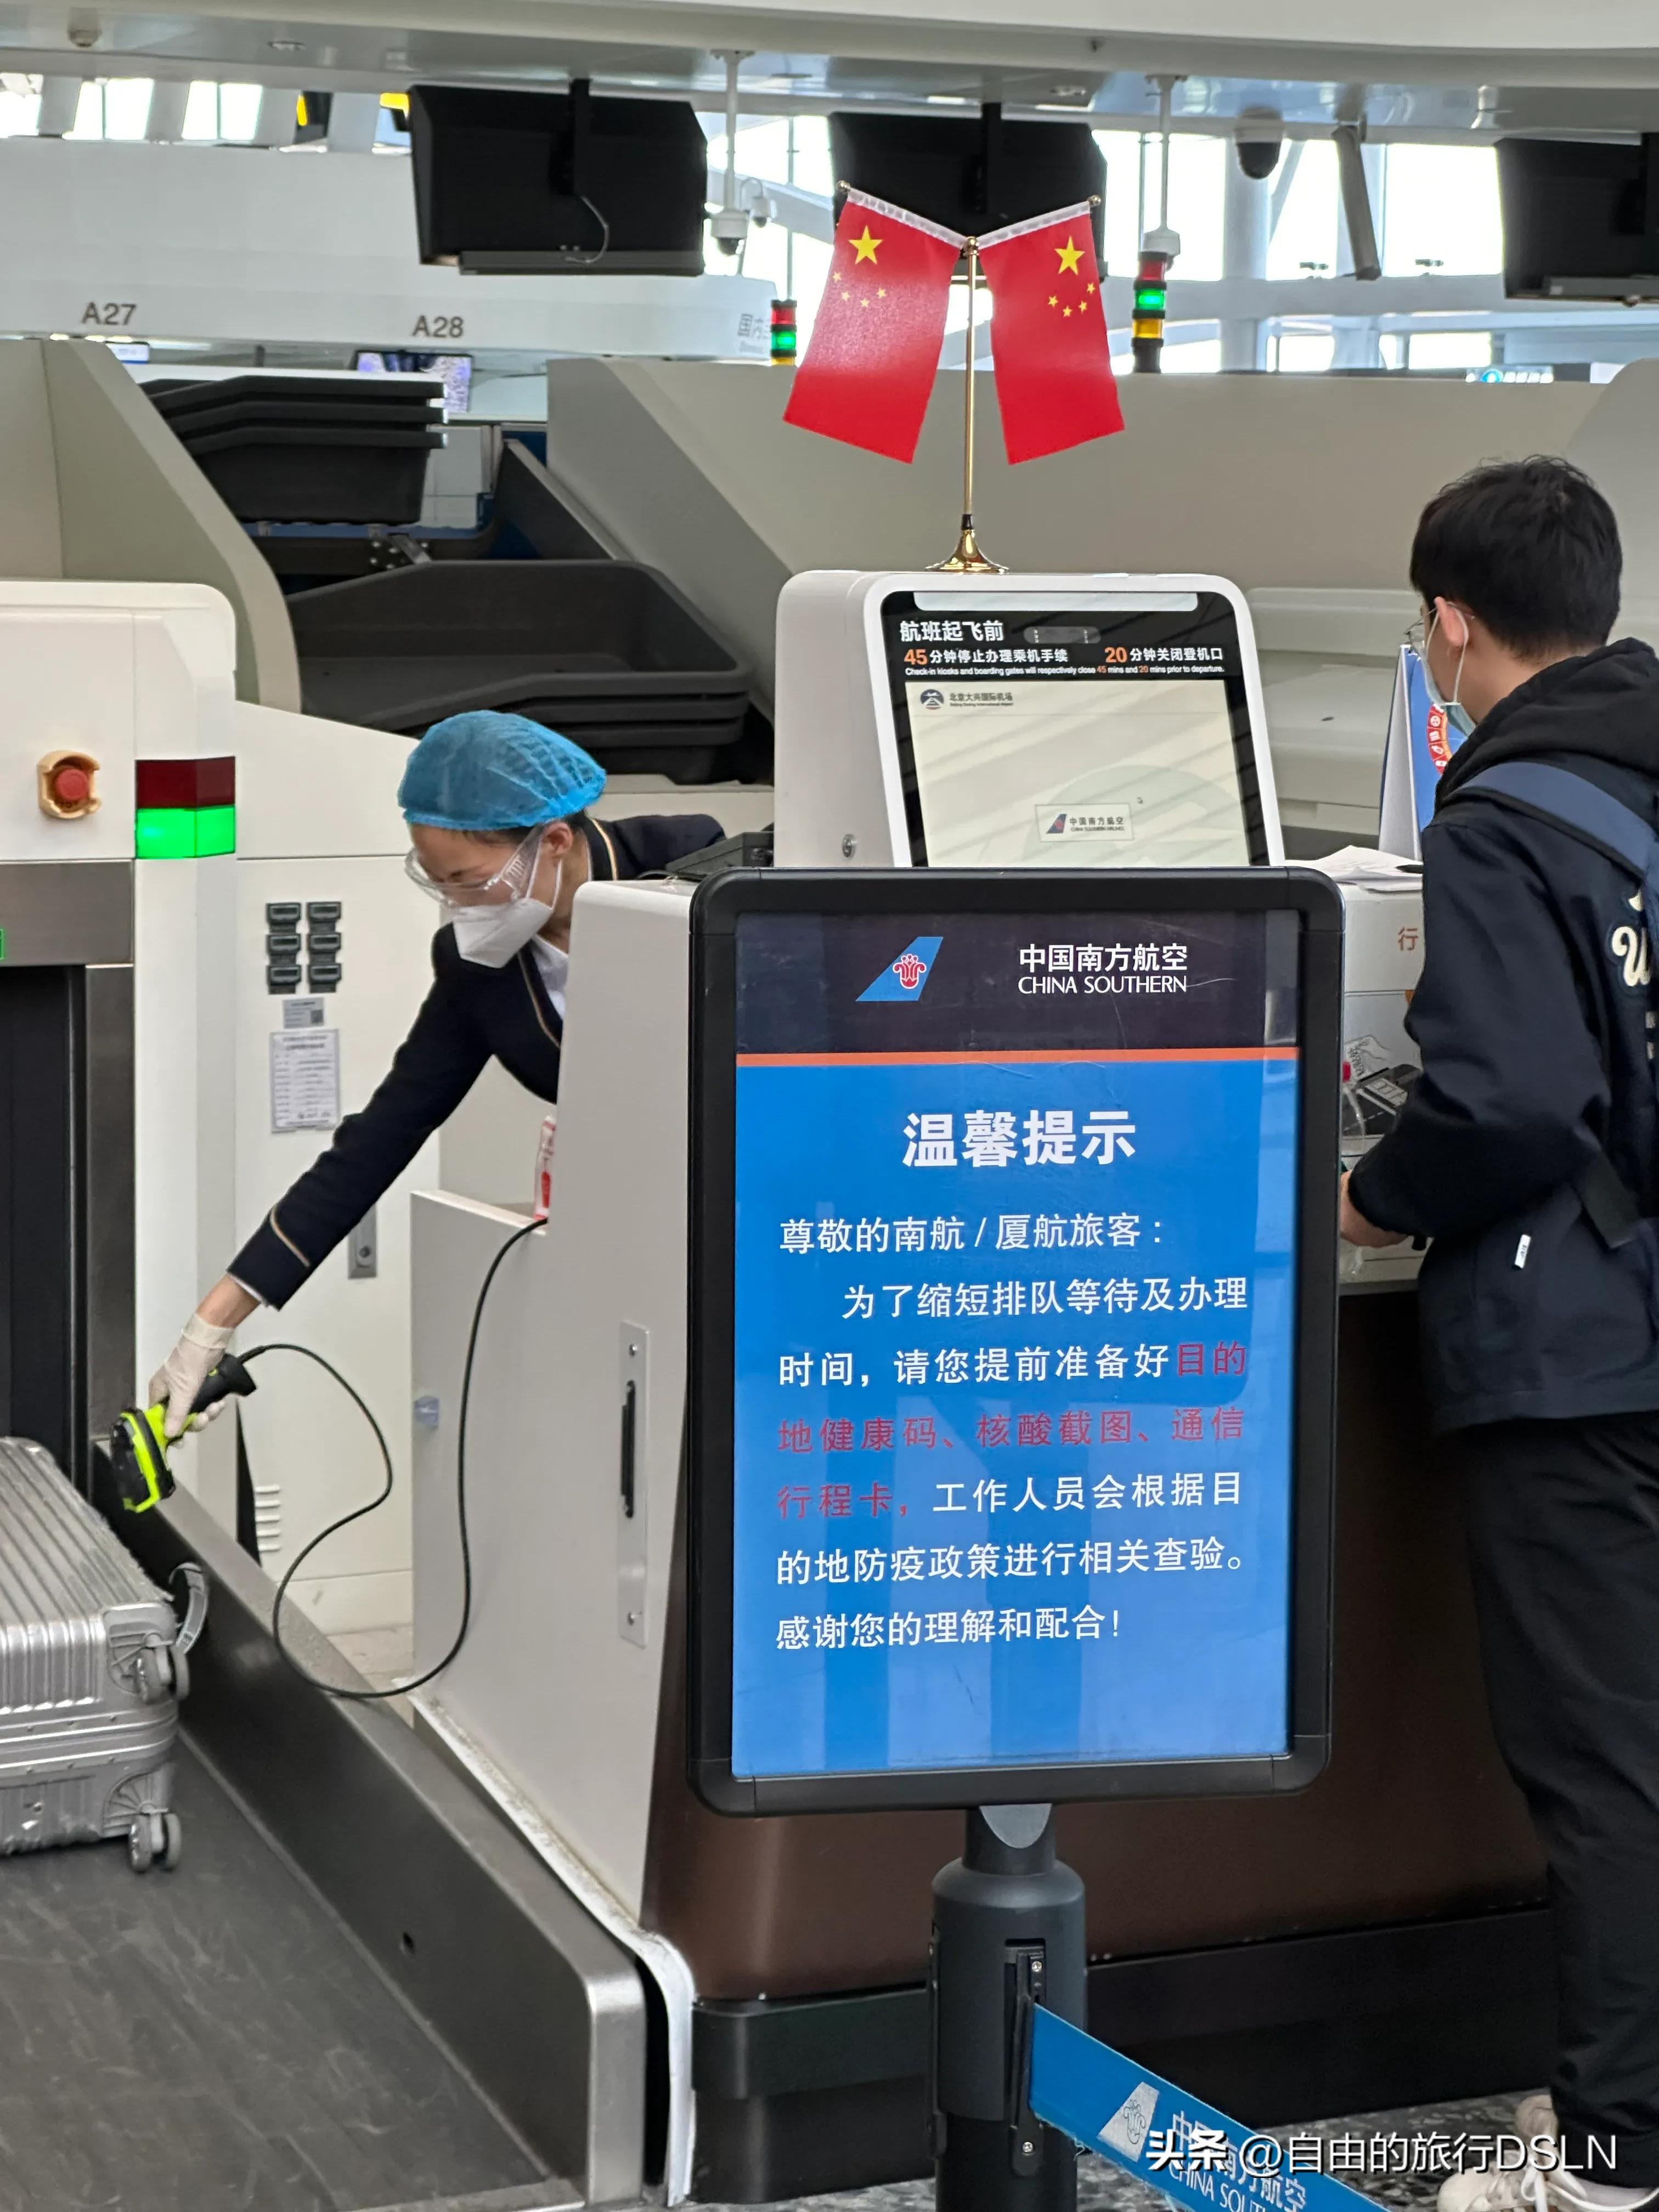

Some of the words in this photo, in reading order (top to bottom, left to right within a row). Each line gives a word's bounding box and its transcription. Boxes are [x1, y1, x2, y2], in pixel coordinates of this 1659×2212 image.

[81, 302, 138, 326] A27
[411, 315, 464, 339] A28
[900, 620, 1004, 642] 航班起飞前
[974, 667, 1005, 676] boarding
[1005, 667, 1024, 676] gates
[1037, 666, 1076, 675] respectively
[1097, 665, 1107, 674] 45
[1167, 665, 1182, 674] prior
[1191, 665, 1225, 674] departure.
[1069, 816, 1124, 826] 中国南方航空
[1397, 927, 1419, 951] 行
[1019, 943, 1188, 973] 中国南方航空
[1018, 976, 1078, 995] CHINA
[1084, 975, 1187, 994] SOUTHERN
[902, 1110, 1136, 1167] 温馨提示
[842, 1277, 1248, 1319] 为了缩短排队等待及办理
[778, 1407, 1244, 1453] 地健康码、核酸截图、通信
[777, 1536, 1242, 1585] 的地防疫政策进行相关查验。
[776, 1605, 1120, 1650] 感谢您的理解和配合！
